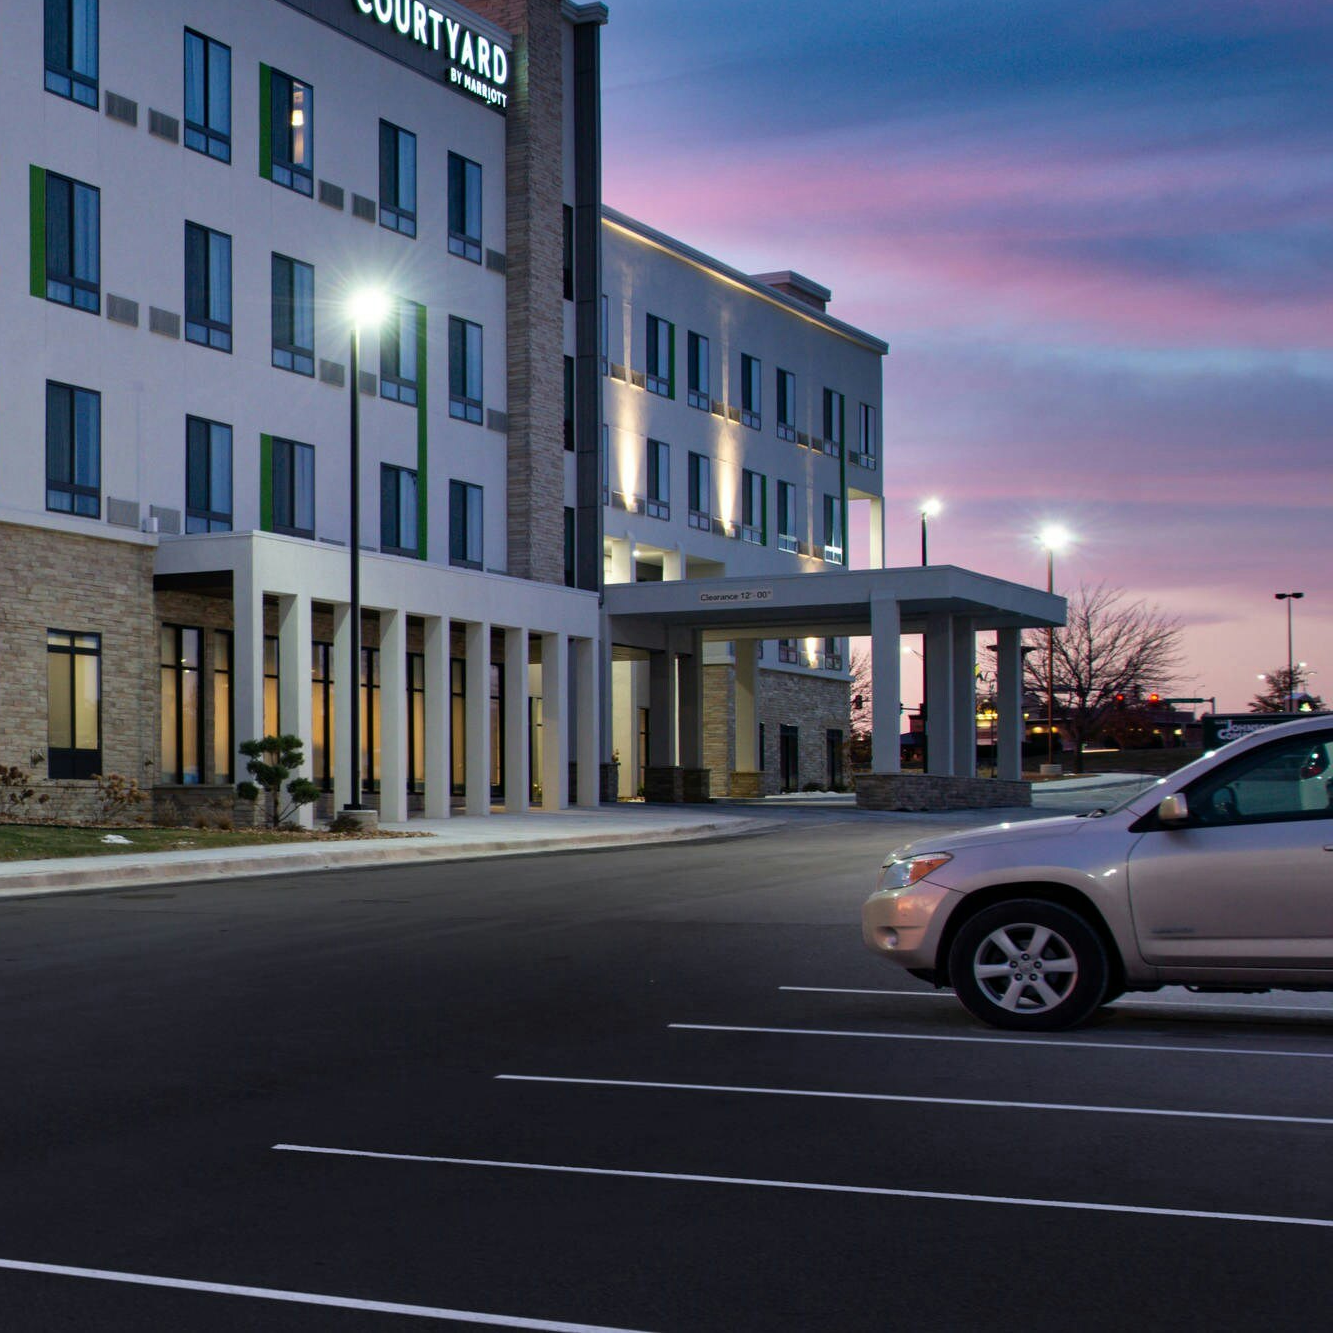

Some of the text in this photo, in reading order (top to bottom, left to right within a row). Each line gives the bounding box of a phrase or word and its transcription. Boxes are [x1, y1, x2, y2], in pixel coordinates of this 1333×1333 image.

[450, 67, 507, 107] BY MARRIOTT
[700, 593, 738, 601] Clearance
